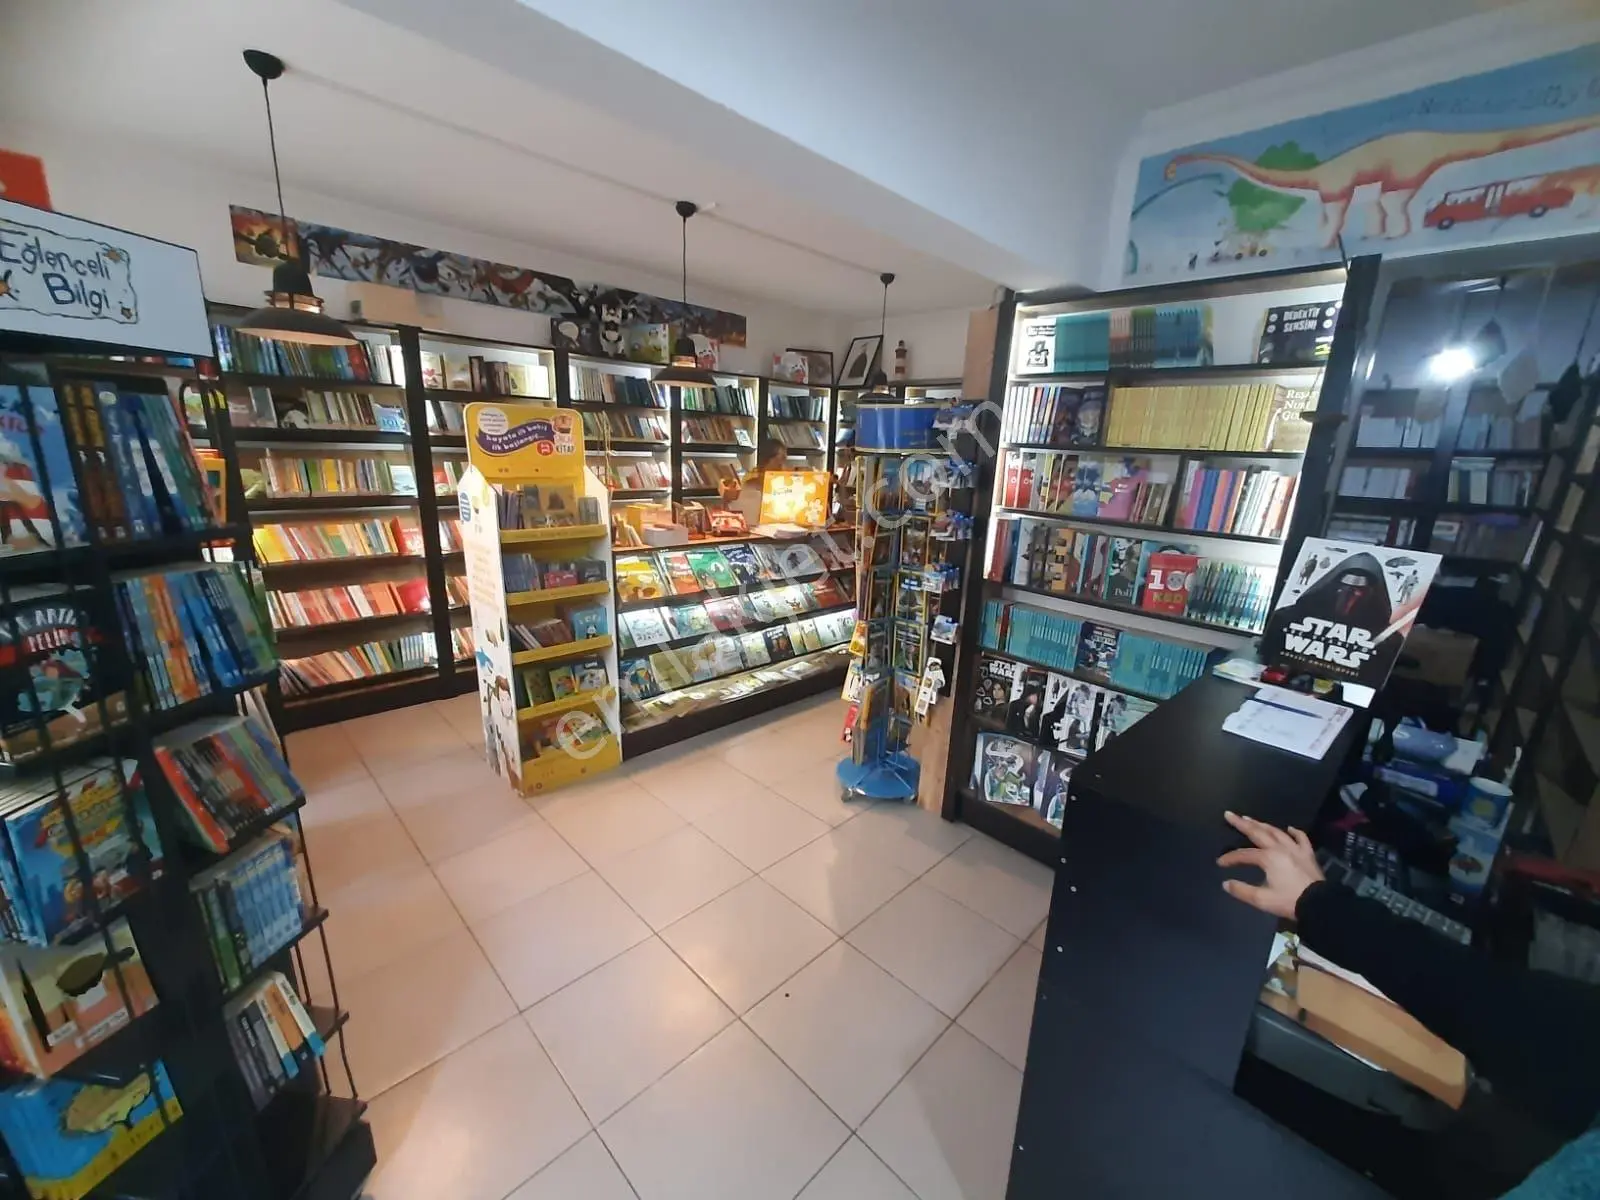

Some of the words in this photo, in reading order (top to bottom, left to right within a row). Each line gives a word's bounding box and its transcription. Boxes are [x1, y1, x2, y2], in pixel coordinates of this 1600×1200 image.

[43, 273, 110, 315] Bilgi
[1289, 616, 1376, 649] STAR
[1285, 633, 1370, 668] WARS
